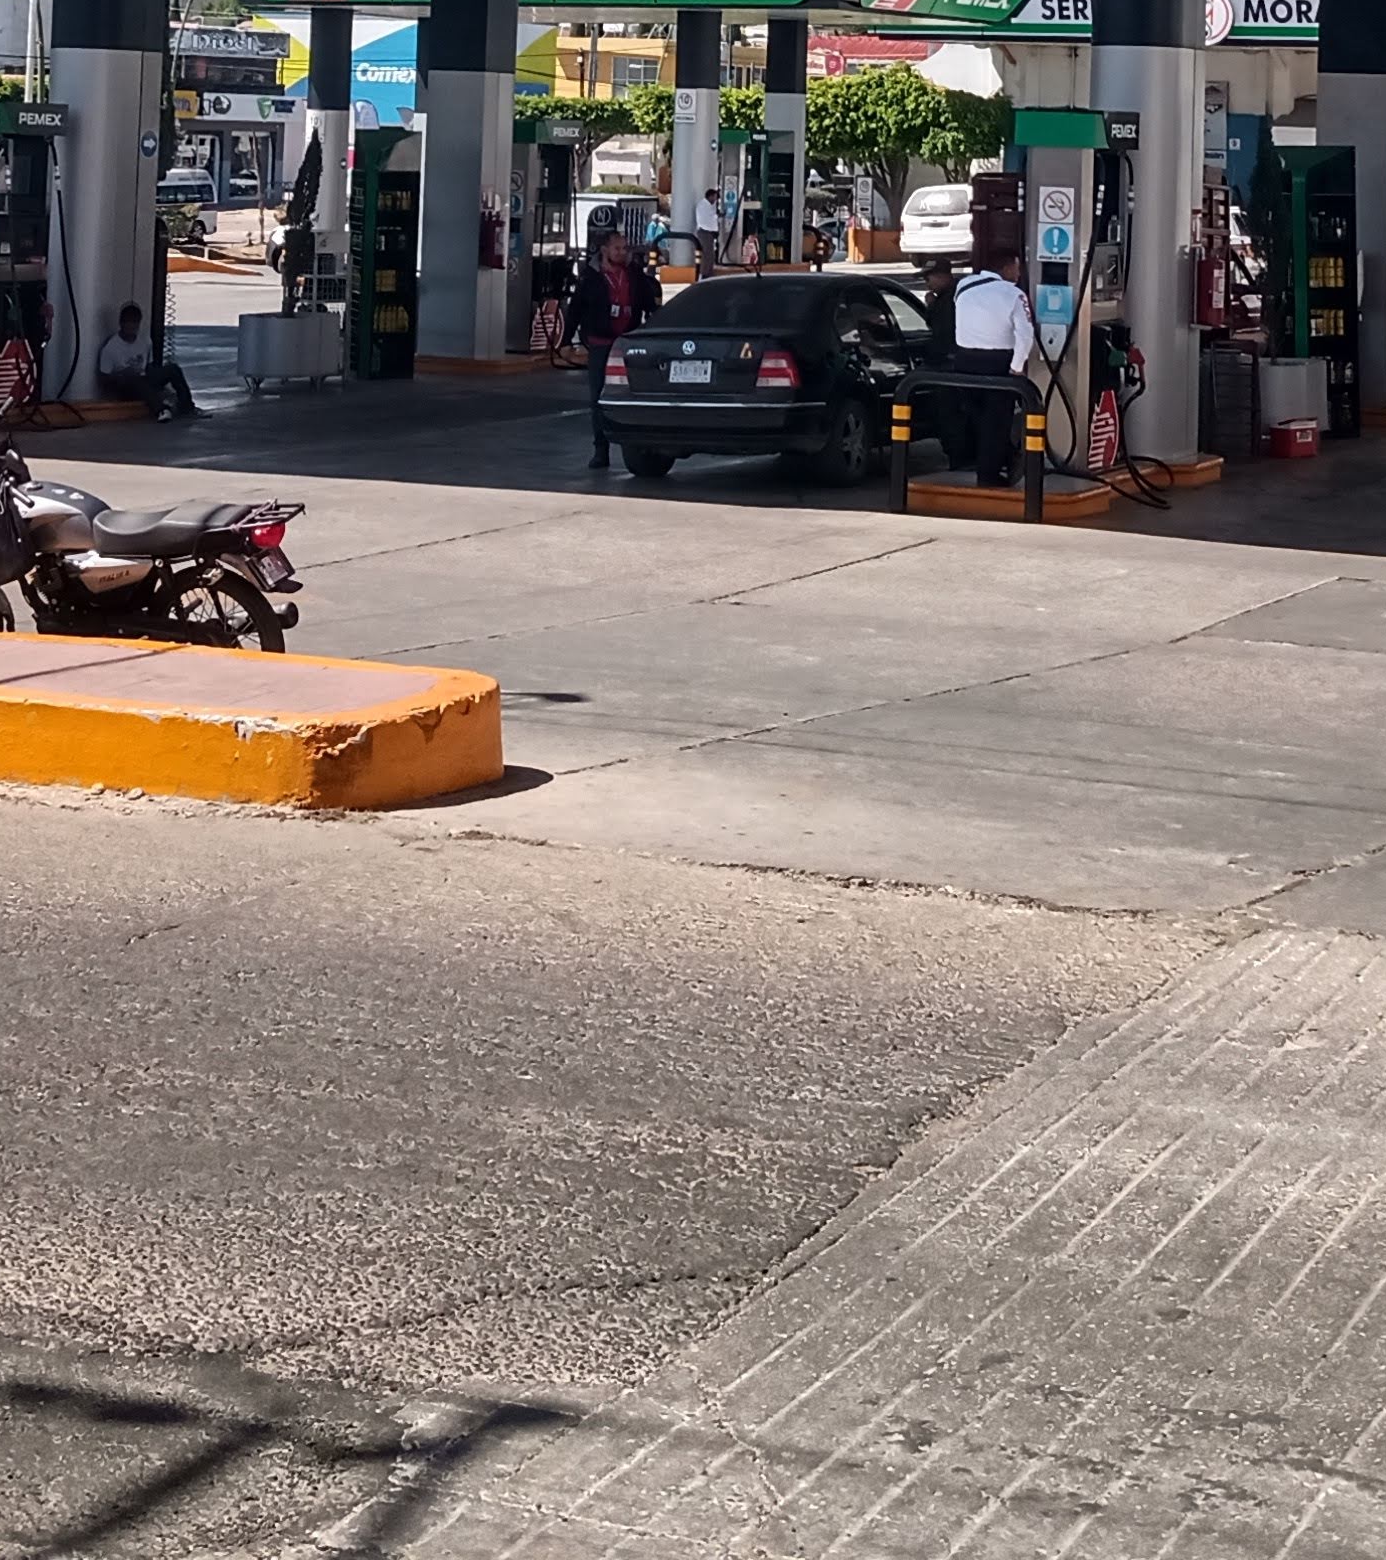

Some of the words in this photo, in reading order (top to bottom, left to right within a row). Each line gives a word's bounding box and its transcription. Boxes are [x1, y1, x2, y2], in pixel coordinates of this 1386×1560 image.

[19, 112, 62, 126] PEMEX
[553, 127, 580, 138] PEMEX
[1111, 124, 1136, 139] PEMEX
